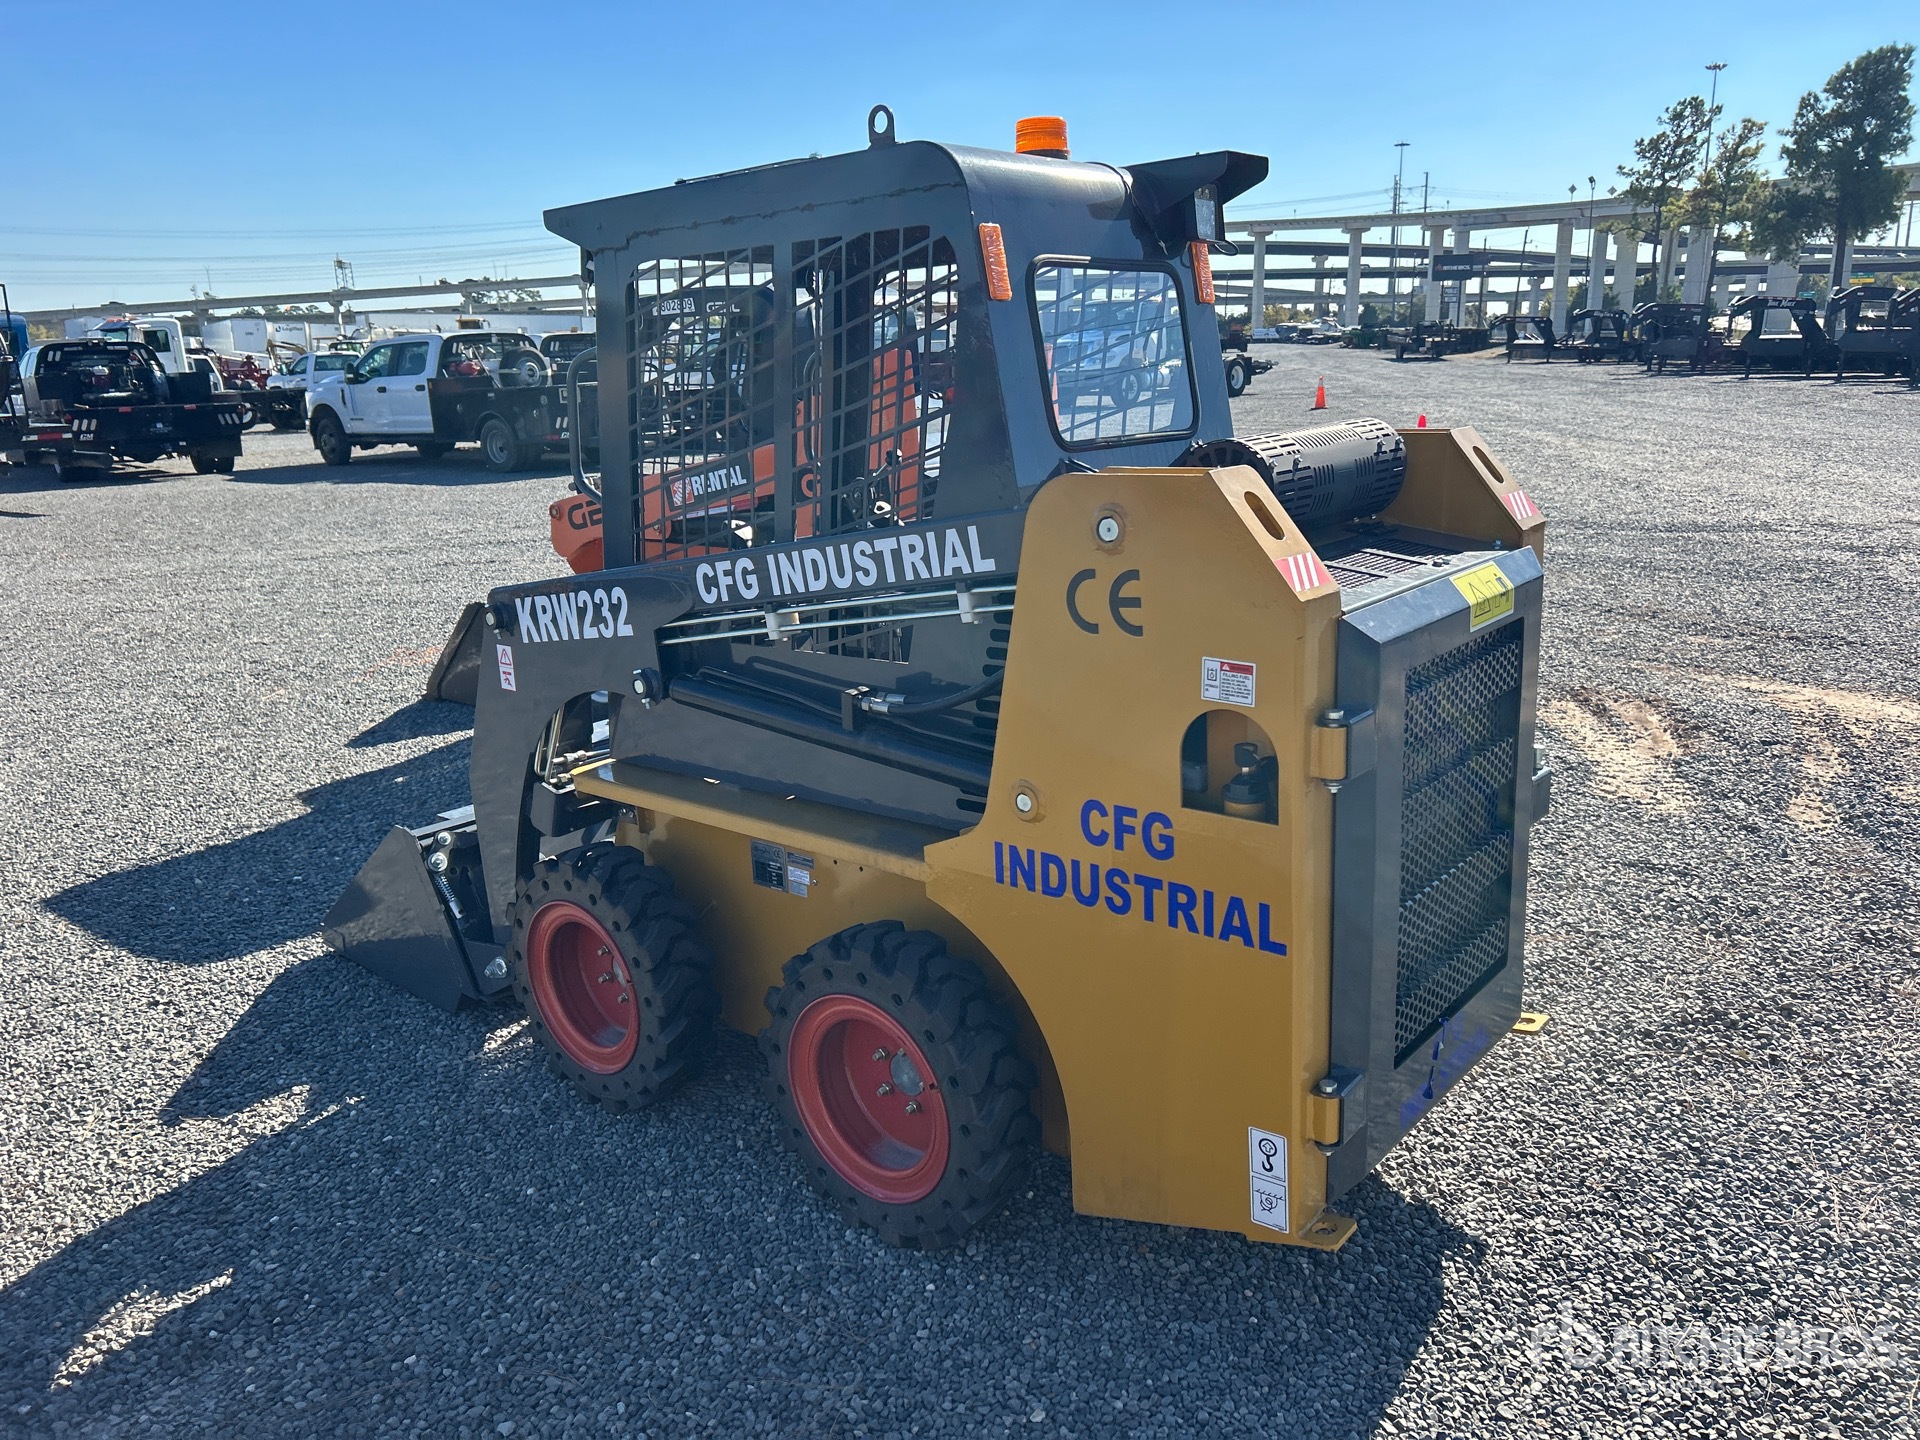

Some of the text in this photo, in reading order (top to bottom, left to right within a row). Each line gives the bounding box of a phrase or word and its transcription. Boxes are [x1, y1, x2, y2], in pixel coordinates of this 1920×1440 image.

[690, 465, 747, 496] RENTAL
[567, 499, 603, 530] GE
[696, 525, 996, 605] CFG INDUSTRIAL
[514, 586, 634, 644] KRW232
[1066, 568, 1144, 637] CE
[1080, 799, 1175, 861] CFG
[994, 841, 1287, 957] INDUSTRIAL
